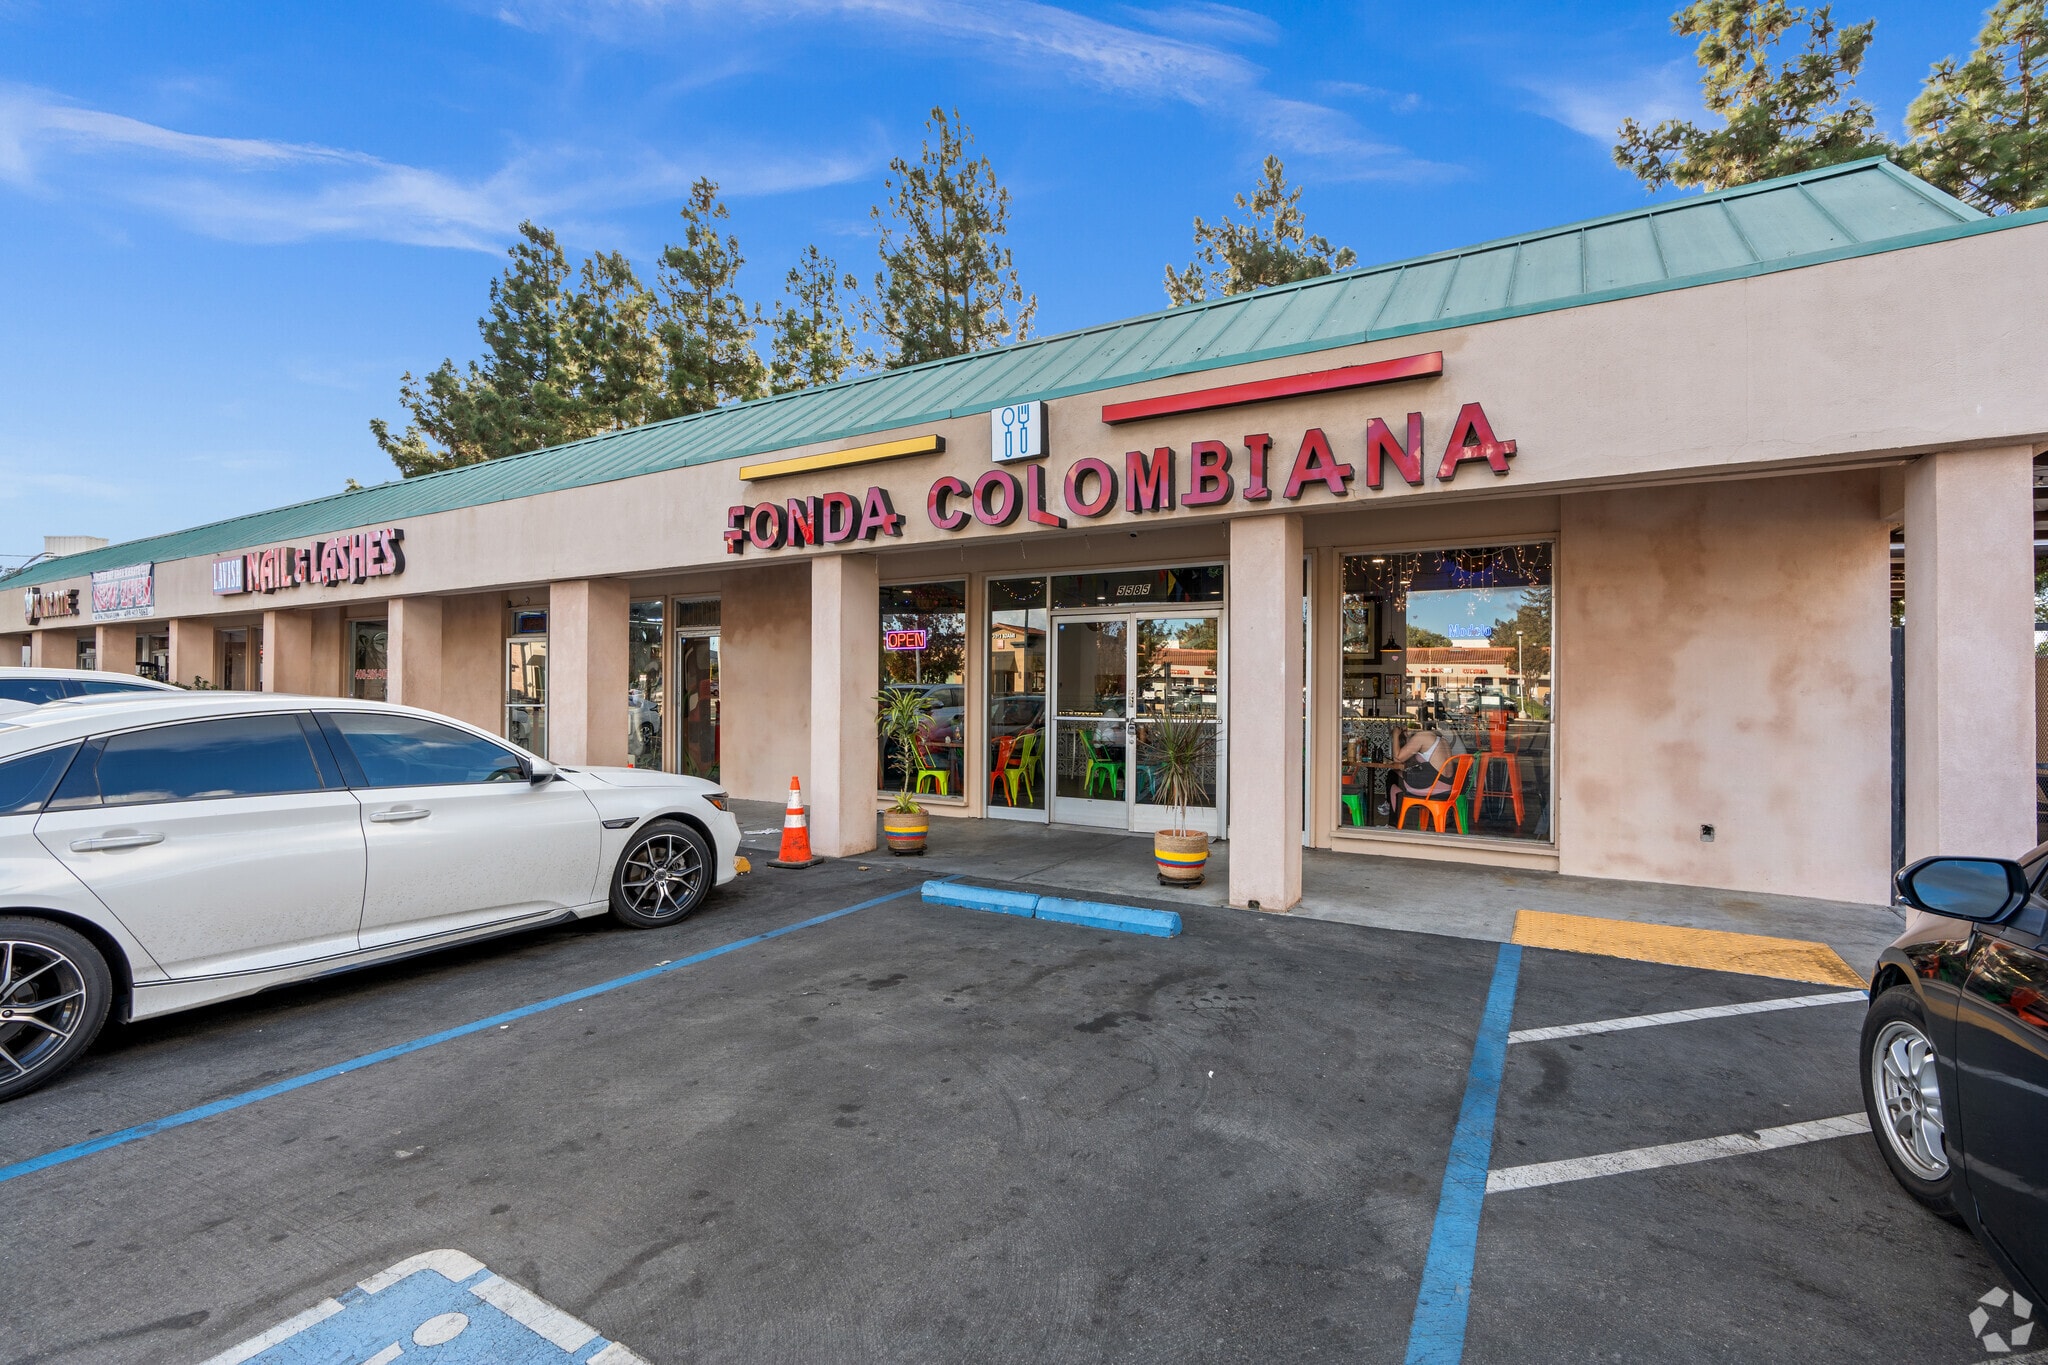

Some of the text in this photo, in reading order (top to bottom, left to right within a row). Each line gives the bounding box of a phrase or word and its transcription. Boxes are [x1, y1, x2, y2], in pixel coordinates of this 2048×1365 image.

[723, 402, 1517, 555] FONDA COLOMBIANA
[247, 547, 294, 593] NAIL
[310, 528, 405, 587] LASHES
[1116, 584, 1151, 595] 5585
[1448, 624, 1493, 638] Modelo
[888, 632, 924, 648] OPEN
